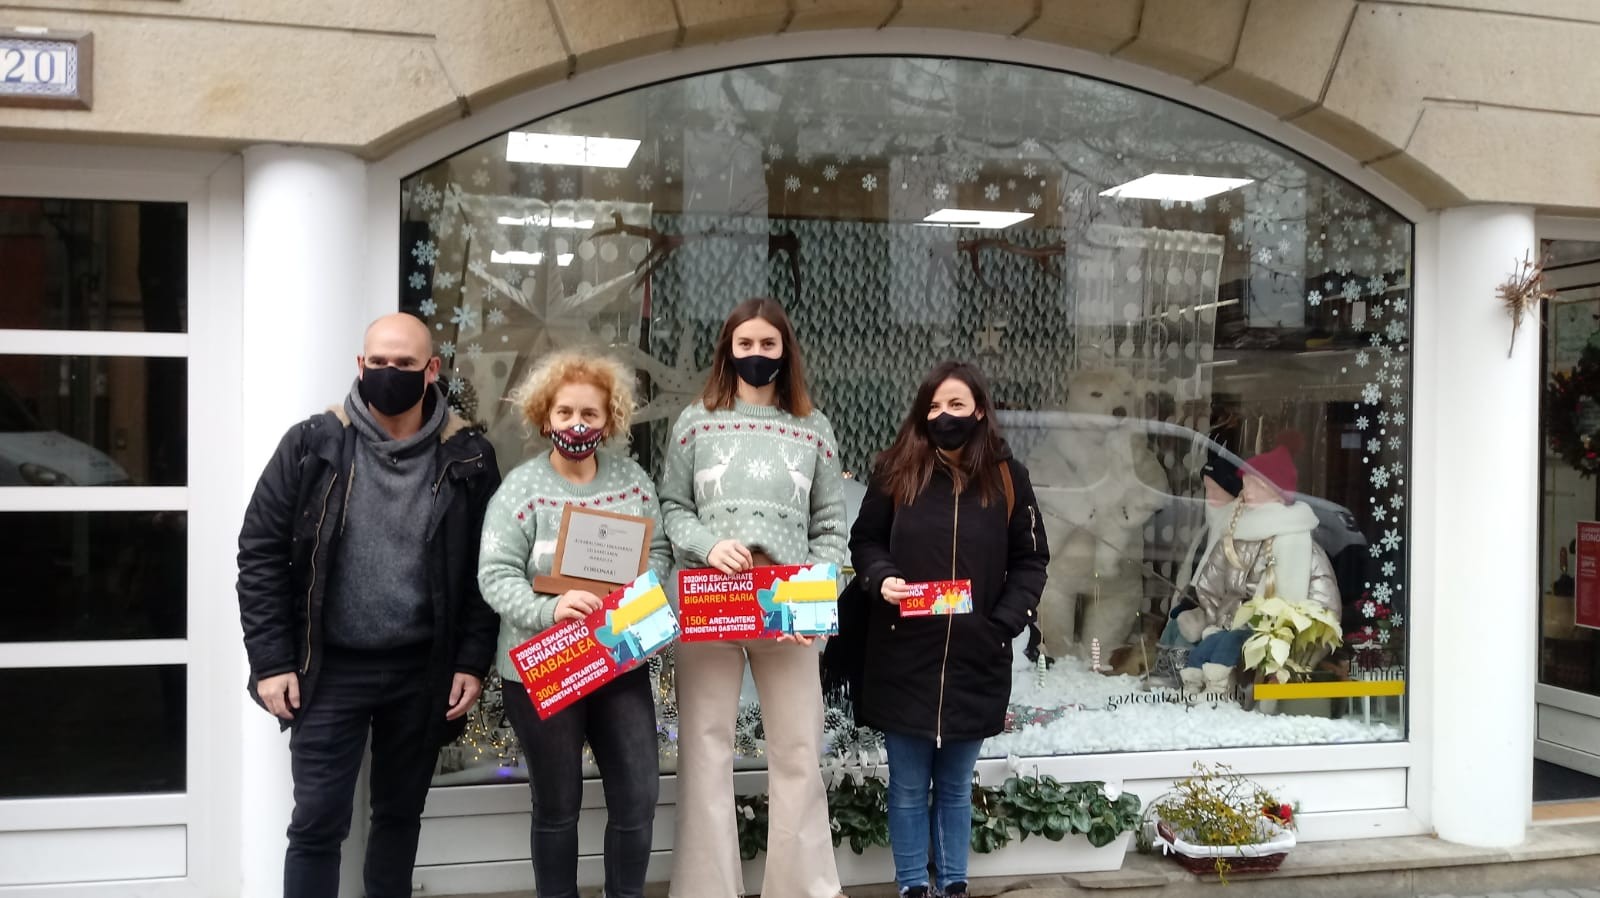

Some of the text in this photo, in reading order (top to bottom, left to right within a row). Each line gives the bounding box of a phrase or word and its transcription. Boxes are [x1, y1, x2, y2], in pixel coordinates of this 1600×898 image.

[5, 48, 55, 84] 20
[683, 575, 708, 583] 2020KO
[684, 581, 753, 594] LEHIAKETAKO
[684, 593, 755, 604] BIGARREN SARIA
[906, 598, 925, 608] 50€
[685, 624, 756, 634] DENDETAN GASTATZEKO
[686, 615, 756, 626] 150€ ARETXARTEKO
[516, 619, 585, 661] 2020KO ESKAPARATE
[520, 626, 589, 671] LEHIAKETAKO
[525, 637, 596, 683] IRABAZLEA
[536, 657, 606, 701] 300€ ARETXARTEKO
[541, 665, 609, 709] DENDETAN GASTATZEKO
